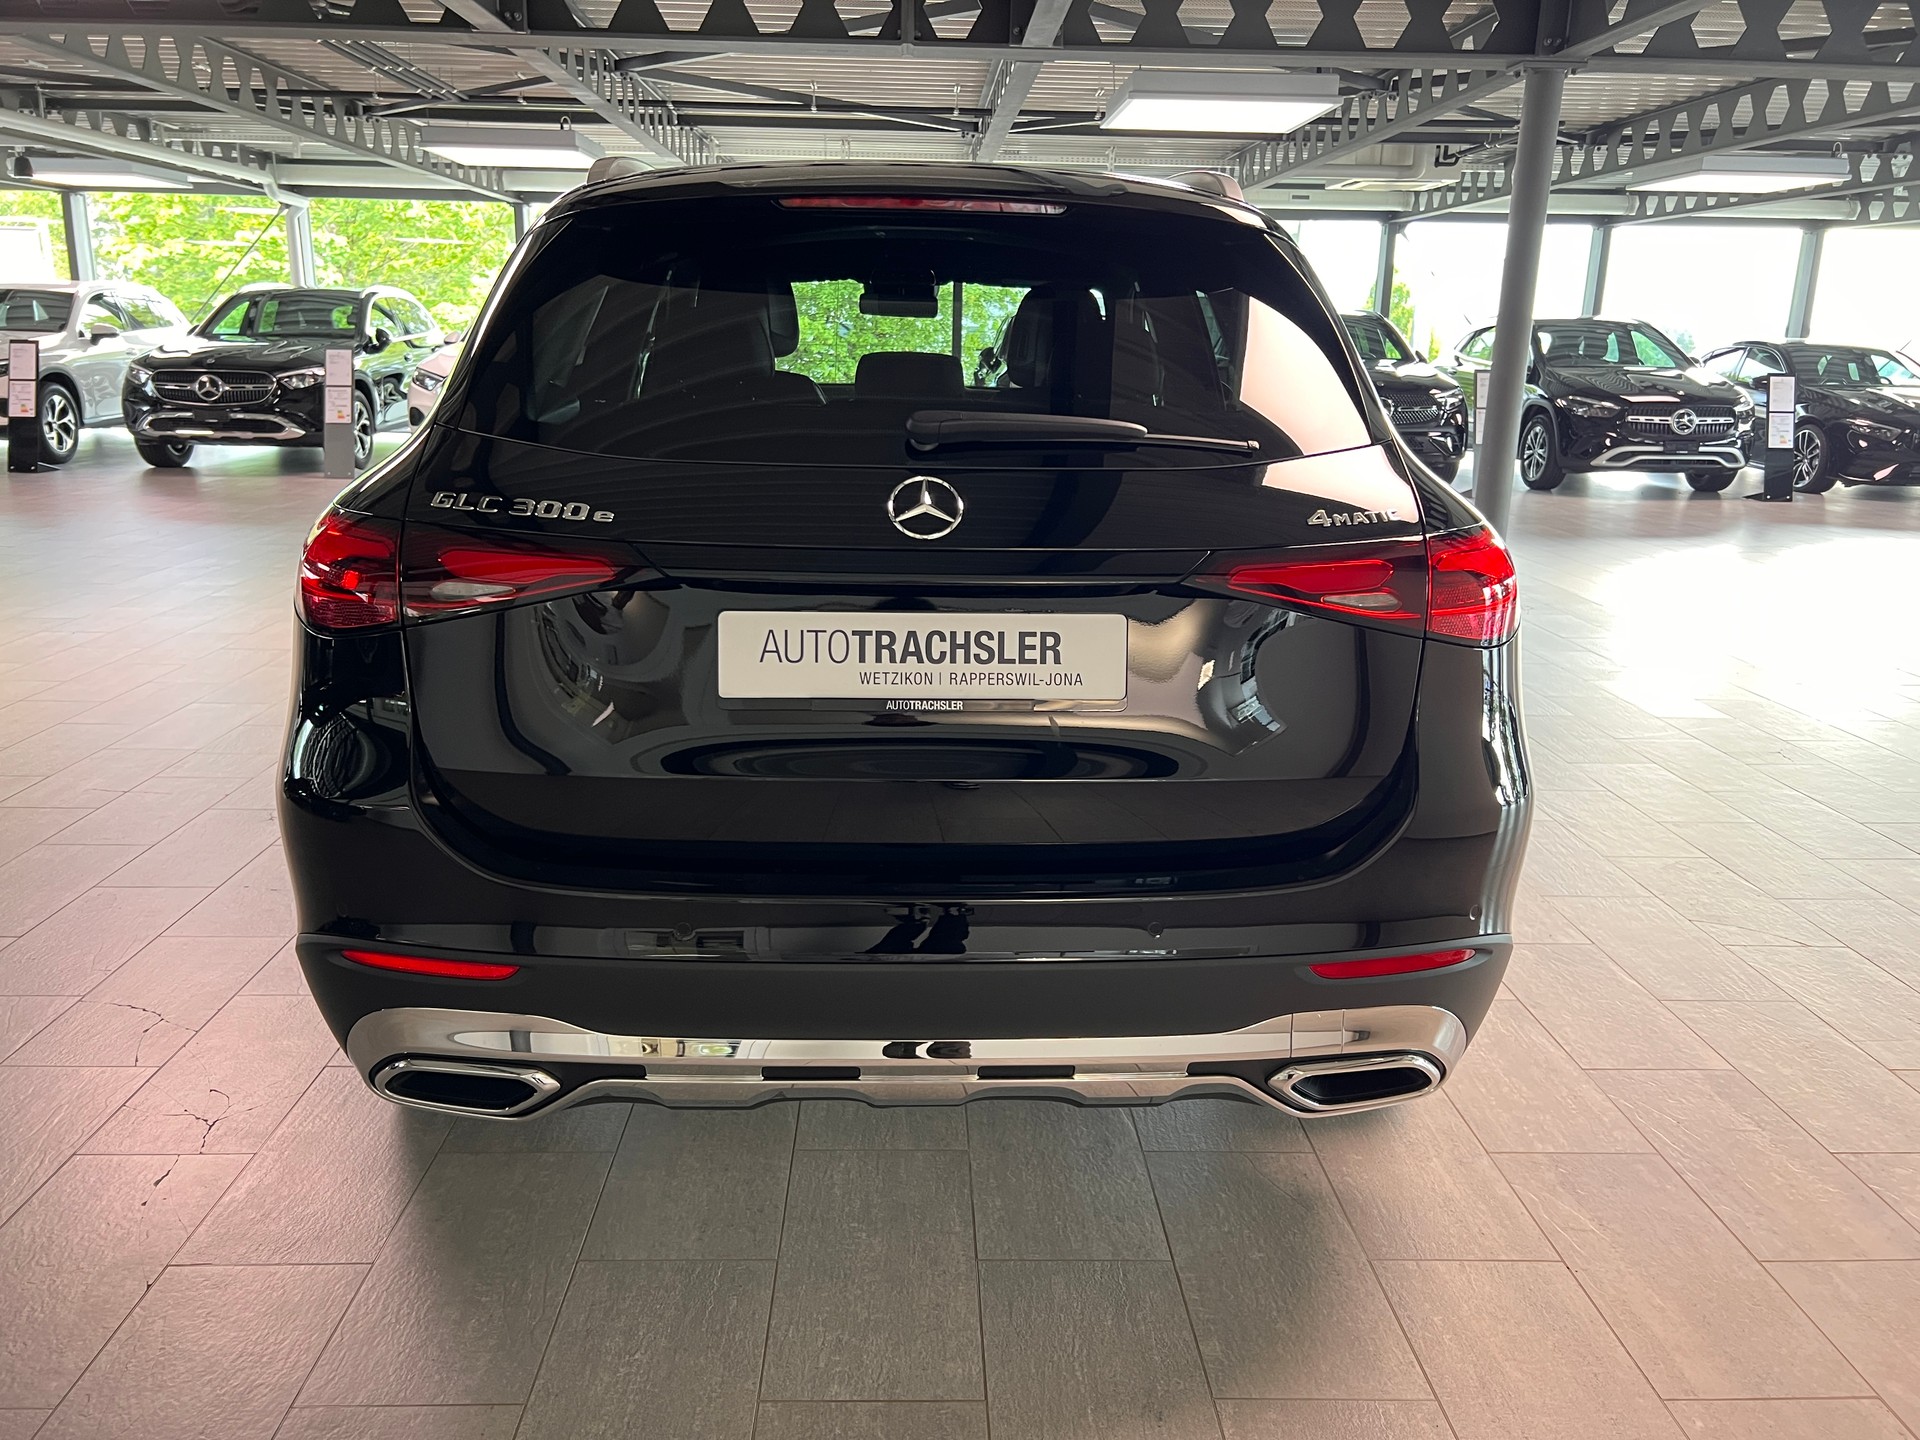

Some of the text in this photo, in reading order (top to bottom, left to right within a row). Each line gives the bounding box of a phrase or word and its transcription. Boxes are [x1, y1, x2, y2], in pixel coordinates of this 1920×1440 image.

[430, 491, 503, 513] GLC
[1307, 509, 1399, 527] 4MATIC
[759, 628, 1062, 666] AUTOTRACHSLER
[859, 671, 934, 686] WETZIKON
[949, 672, 1083, 687] RAPPERSWIL-JONA
[885, 700, 964, 711] AUTOTRACHSLER
